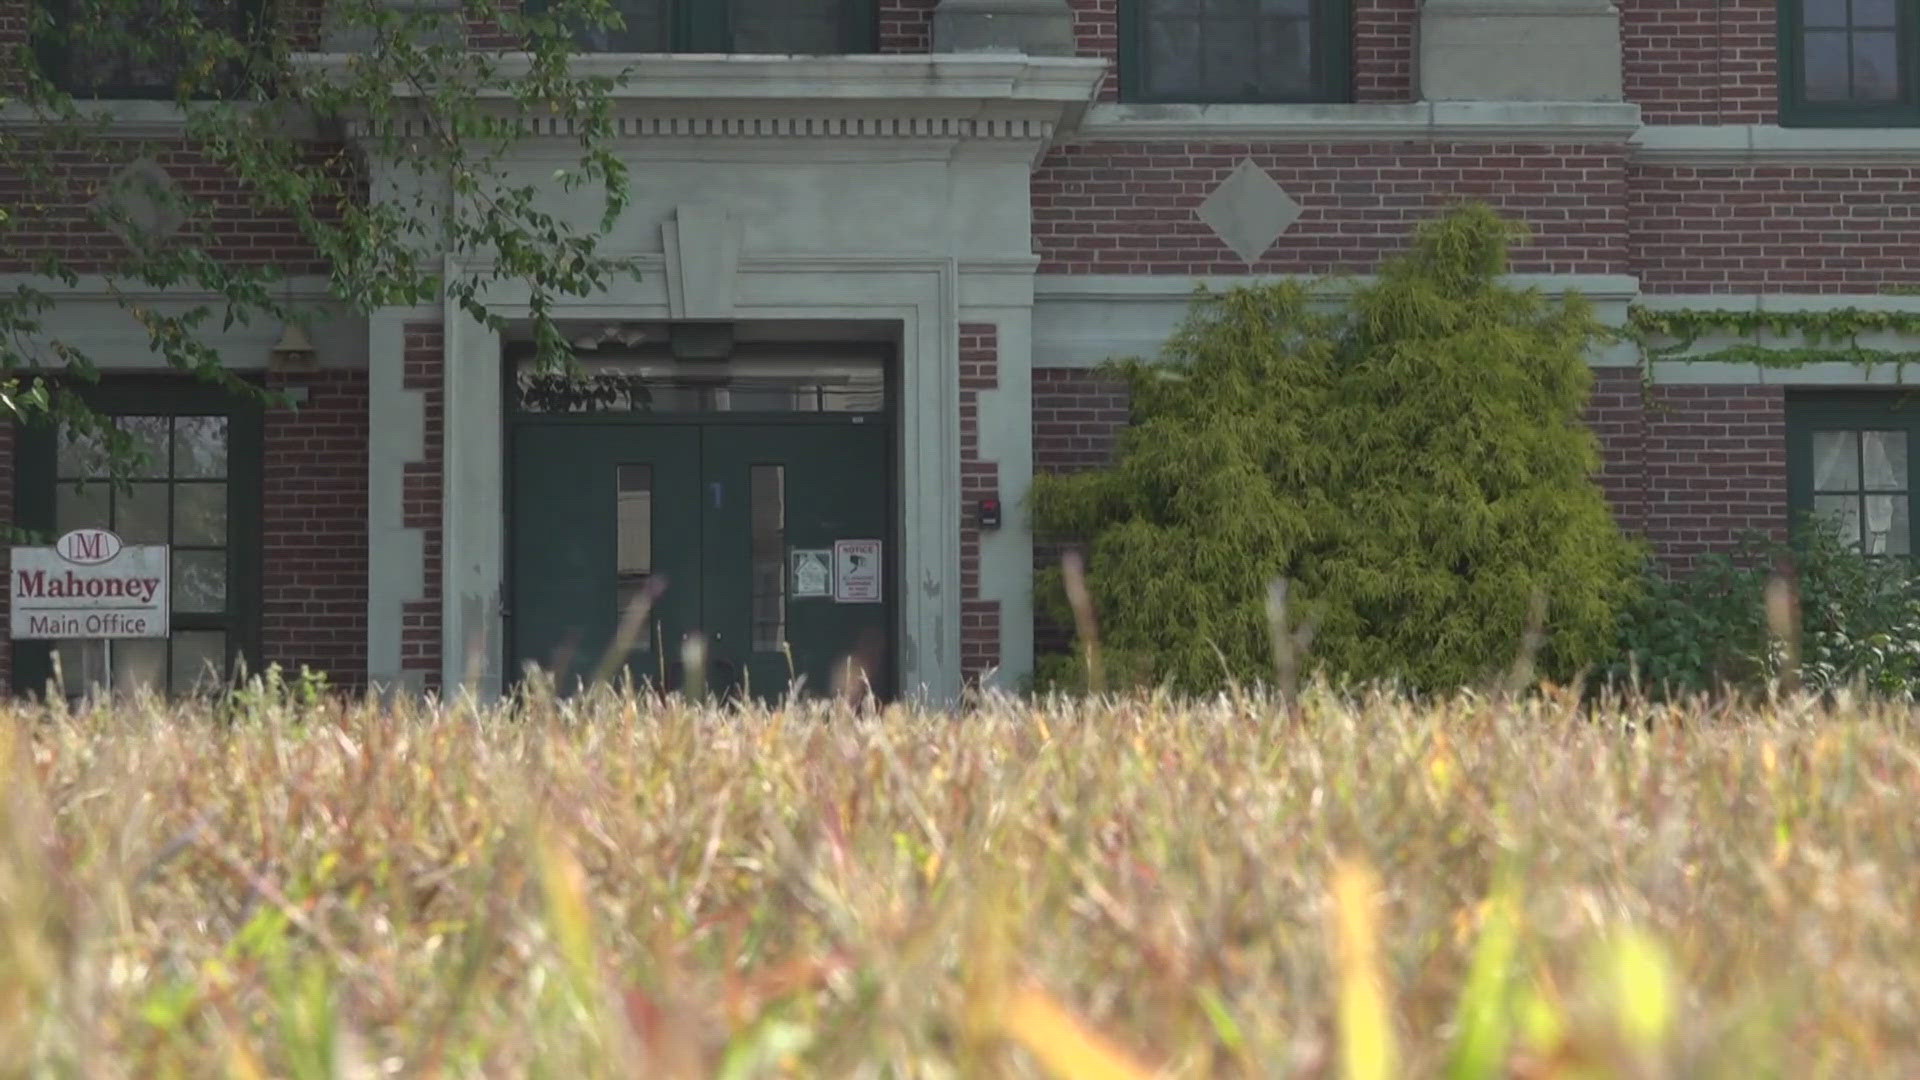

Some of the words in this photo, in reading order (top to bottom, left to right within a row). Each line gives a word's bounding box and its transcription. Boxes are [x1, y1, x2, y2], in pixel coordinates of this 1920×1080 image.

[74, 533, 104, 560] M
[842, 545, 874, 554] NOTICE
[17, 569, 161, 603] Mahoney
[29, 615, 79, 635] Main
[85, 614, 147, 635] Office
